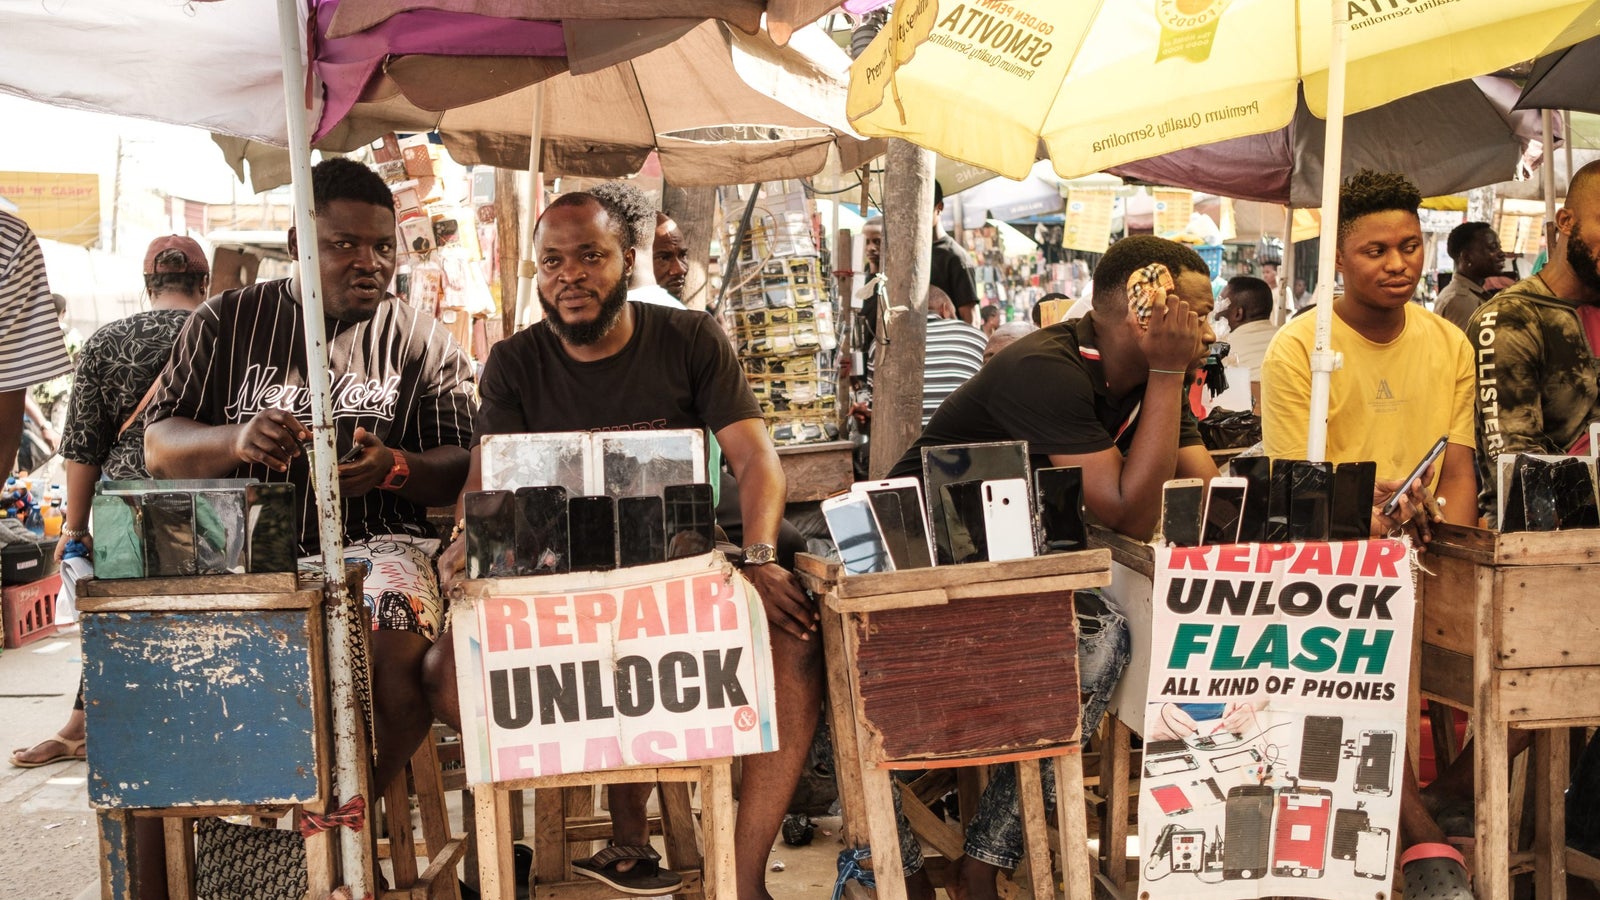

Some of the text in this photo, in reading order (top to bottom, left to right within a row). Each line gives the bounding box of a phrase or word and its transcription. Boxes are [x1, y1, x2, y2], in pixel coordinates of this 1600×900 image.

[51, 186, 94, 195] CARRY
[225, 364, 400, 419] New York
[1479, 311, 1504, 450] HOLLISTER
[1167, 539, 1406, 578] REPAIR
[483, 573, 738, 652] REPAIR
[1166, 577, 1402, 620] UNLOCK
[1167, 623, 1394, 675] FLASH
[488, 646, 749, 730] UNLOCK
[1161, 675, 1396, 701] ALL KIND OF PHONES
[737, 709, 755, 729] &
